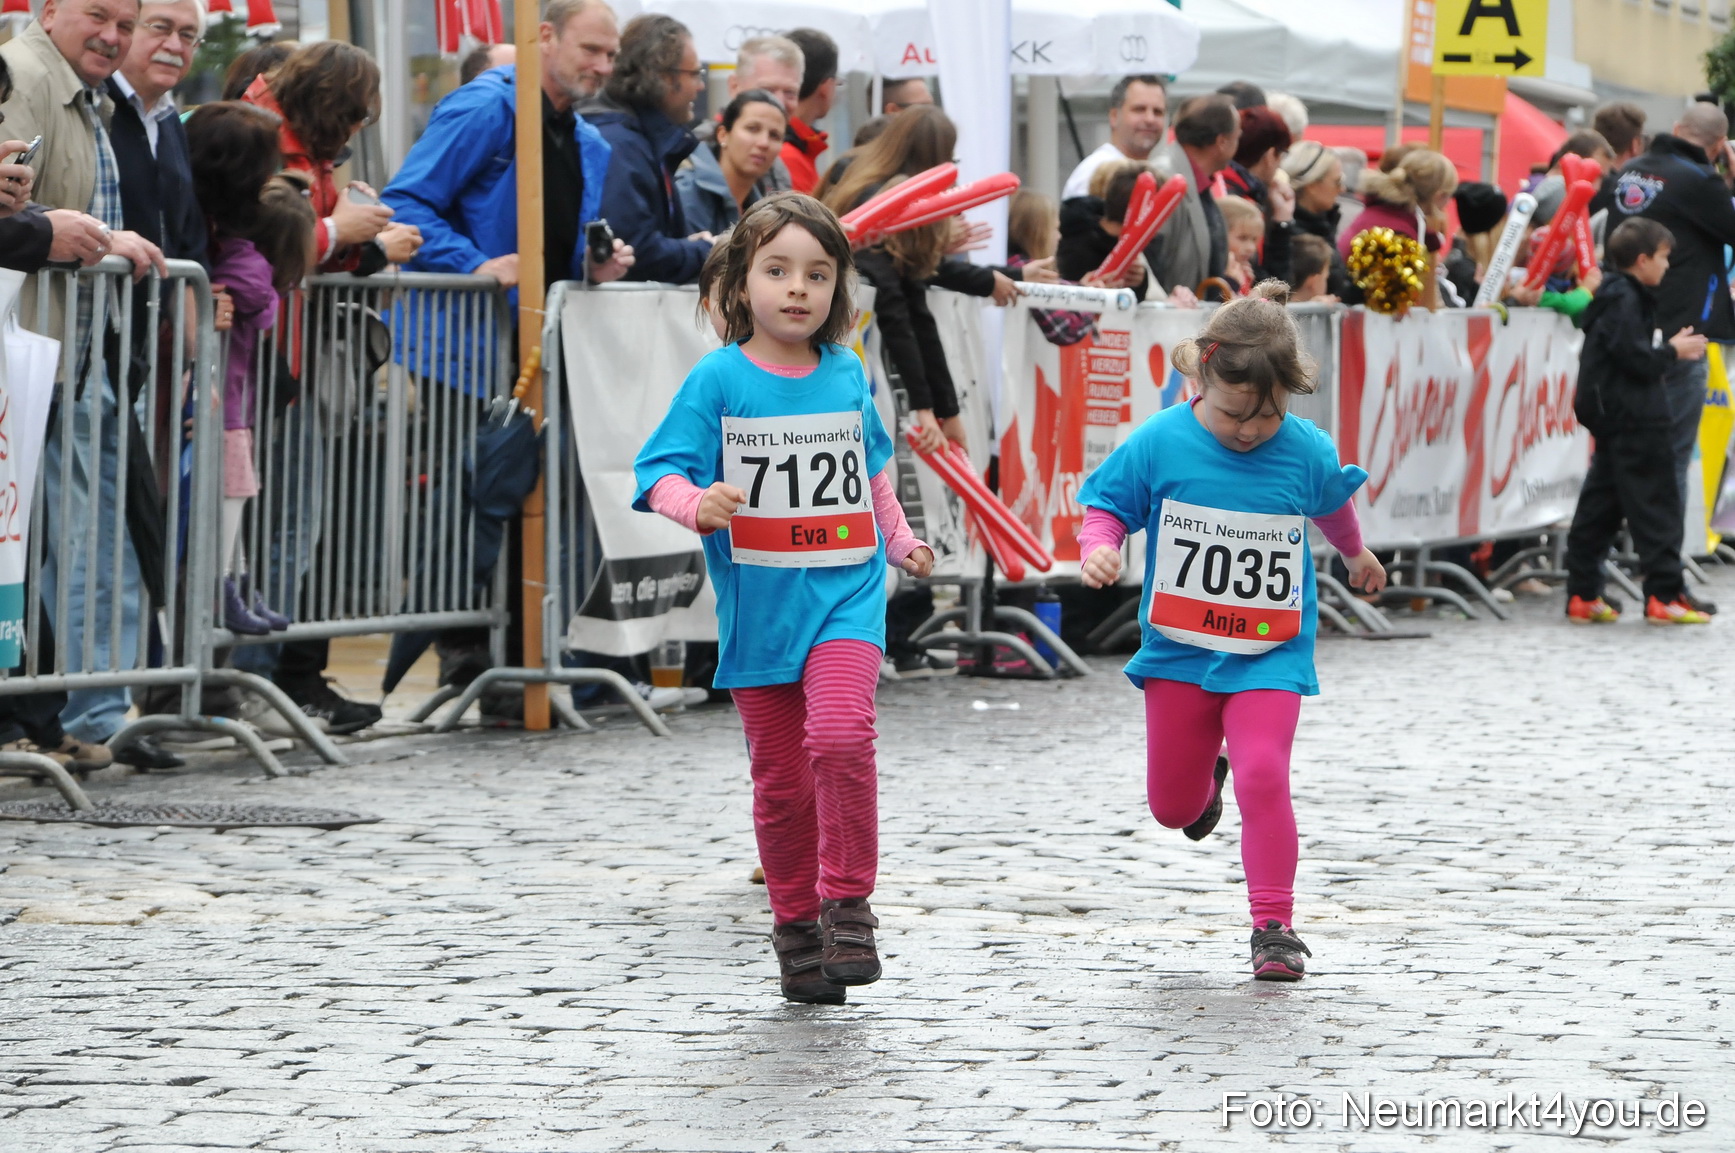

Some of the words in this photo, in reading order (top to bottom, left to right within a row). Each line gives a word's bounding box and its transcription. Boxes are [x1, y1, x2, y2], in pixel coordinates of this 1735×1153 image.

[1458, 0, 1522, 36] A
[901, 42, 936, 65] Au
[1011, 41, 1052, 63] KK
[726, 432, 779, 446] PARTL
[783, 429, 850, 445] Neumarkt
[741, 450, 862, 508] 7128
[791, 525, 827, 546] Eva
[1163, 514, 1211, 533] PARTL
[1216, 524, 1283, 542] Neumarkt
[1174, 538, 1291, 601] 7035
[1203, 609, 1246, 636] Anja
